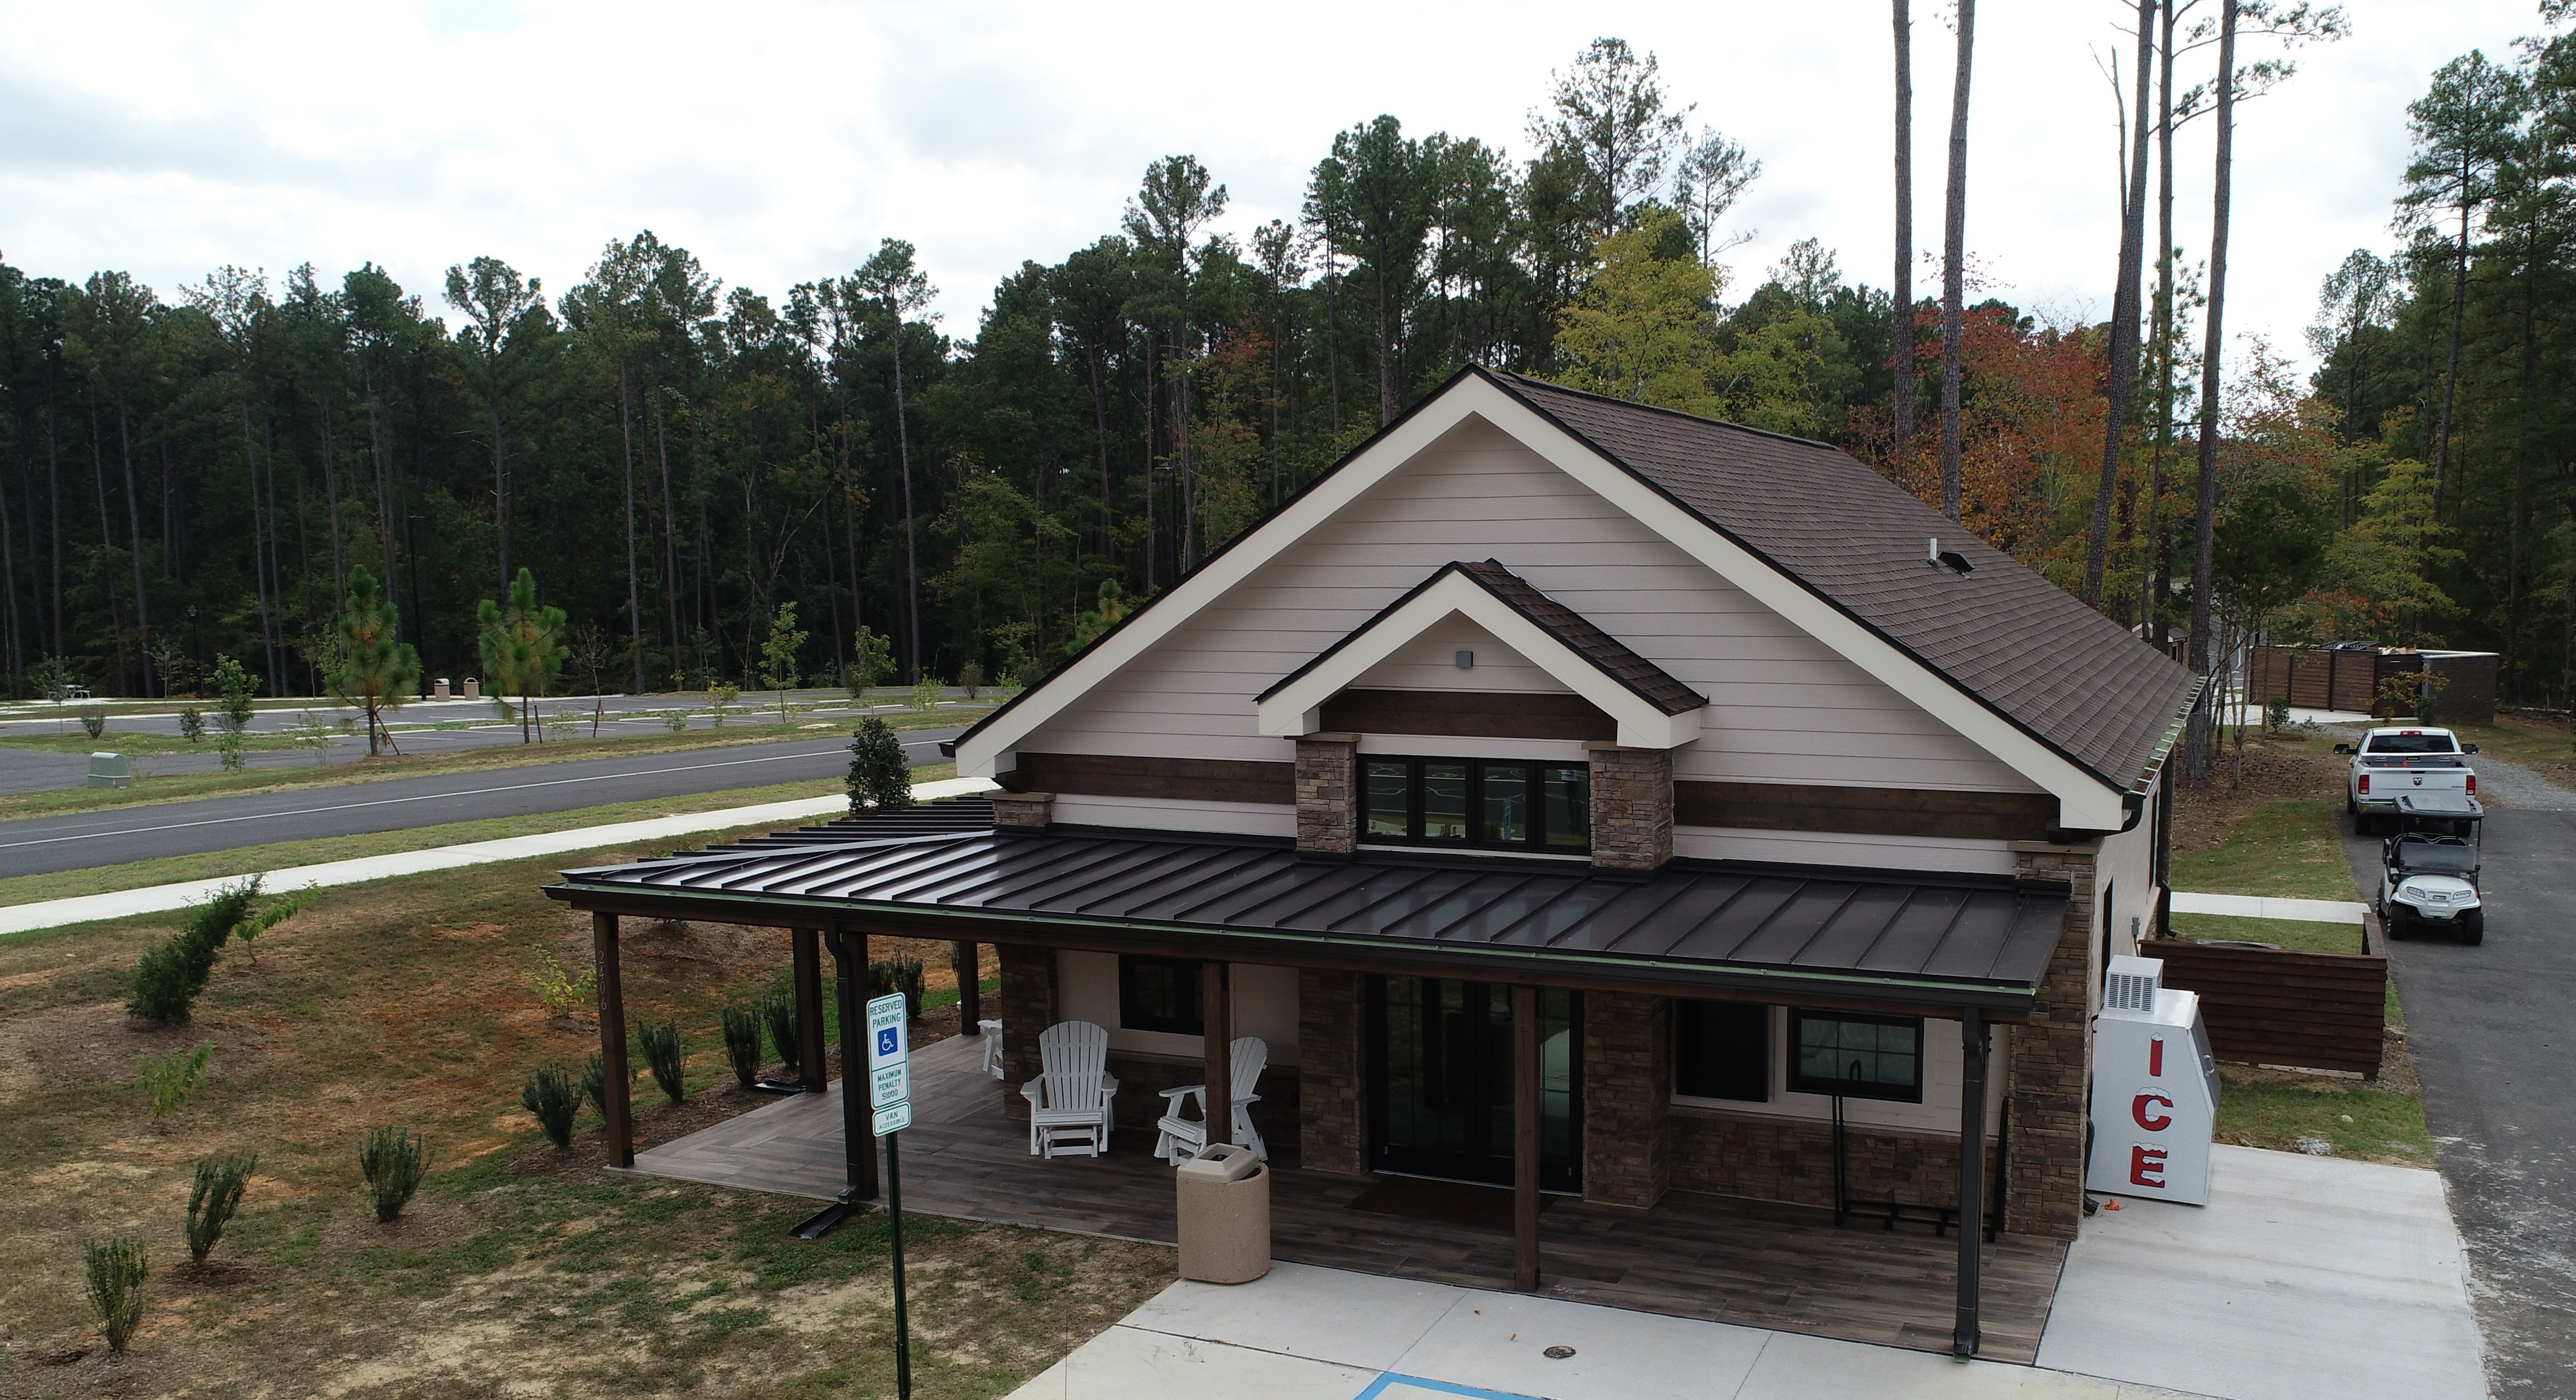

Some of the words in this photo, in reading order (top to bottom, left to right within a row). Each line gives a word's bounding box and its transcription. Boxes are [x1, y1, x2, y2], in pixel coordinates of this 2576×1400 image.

[870, 1000, 902, 1016] RESERVED
[873, 1012, 900, 1028] PARKING
[877, 1069, 901, 1082] MAXIMUM
[879, 1078, 901, 1092] PENALTY
[885, 1111, 898, 1120] VAN
[2130, 1032, 2173, 1188] ICE
[879, 1117, 905, 1130] ACCESSIBLE
